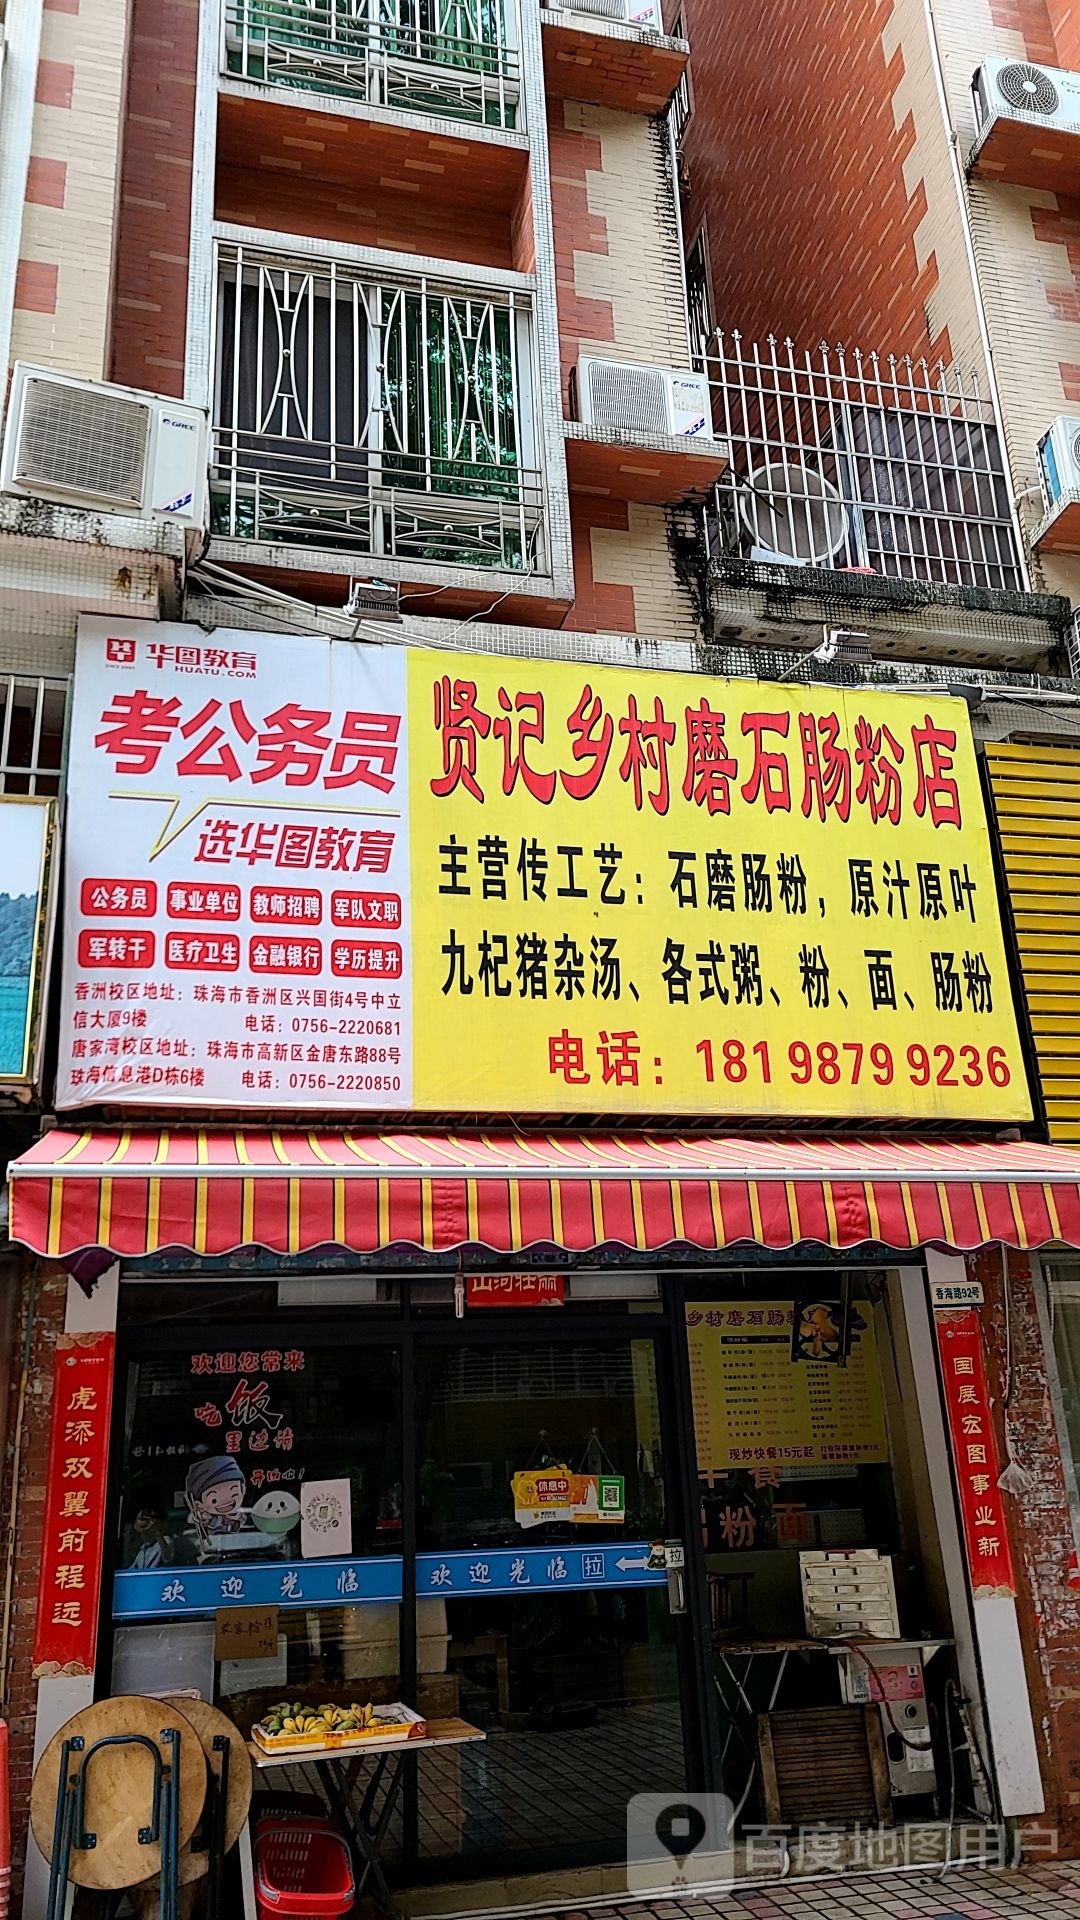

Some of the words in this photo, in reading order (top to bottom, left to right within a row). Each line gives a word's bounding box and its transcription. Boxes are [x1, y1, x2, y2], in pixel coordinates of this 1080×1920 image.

[146, 643, 257, 671] 华图教育
[174, 665, 257, 679] HUATU.COM
[94, 689, 402, 795] 考公务员
[428, 674, 963, 830] 贤记乡村磨石肠粉店
[193, 819, 396, 874] 选华图教育
[90, 886, 149, 911] 公务员
[168, 887, 240, 914] 事业单位
[253, 892, 321, 920] 教师招聘
[334, 897, 400, 923] 军队文职
[87, 936, 147, 962] 军转干
[168, 938, 239, 966] 医疗卫生
[252, 943, 321, 970] 金融银行
[334, 947, 401, 972] 学历提升
[73, 1008, 147, 1029] 信大厦9楼
[69, 1064, 206, 1087] 珠海信息港D栋6楼
[190, 1350, 305, 1376] 欢迎您常来
[225, 1426, 295, 1453] 里边请
[728, 1446, 815, 1461] 现炒快餐15元起
[952, 1356, 1001, 1558] 国展宏图事业新
[538, 1480, 567, 1493] 休息中
[51, 1386, 98, 1627] 虎添双翼前程远
[429, 1555, 569, 1587] 欢迎光临
[584, 1555, 603, 1577] 拉
[668, 1548, 684, 1564] 拉
[160, 1570, 360, 1603] 欢迎光临
